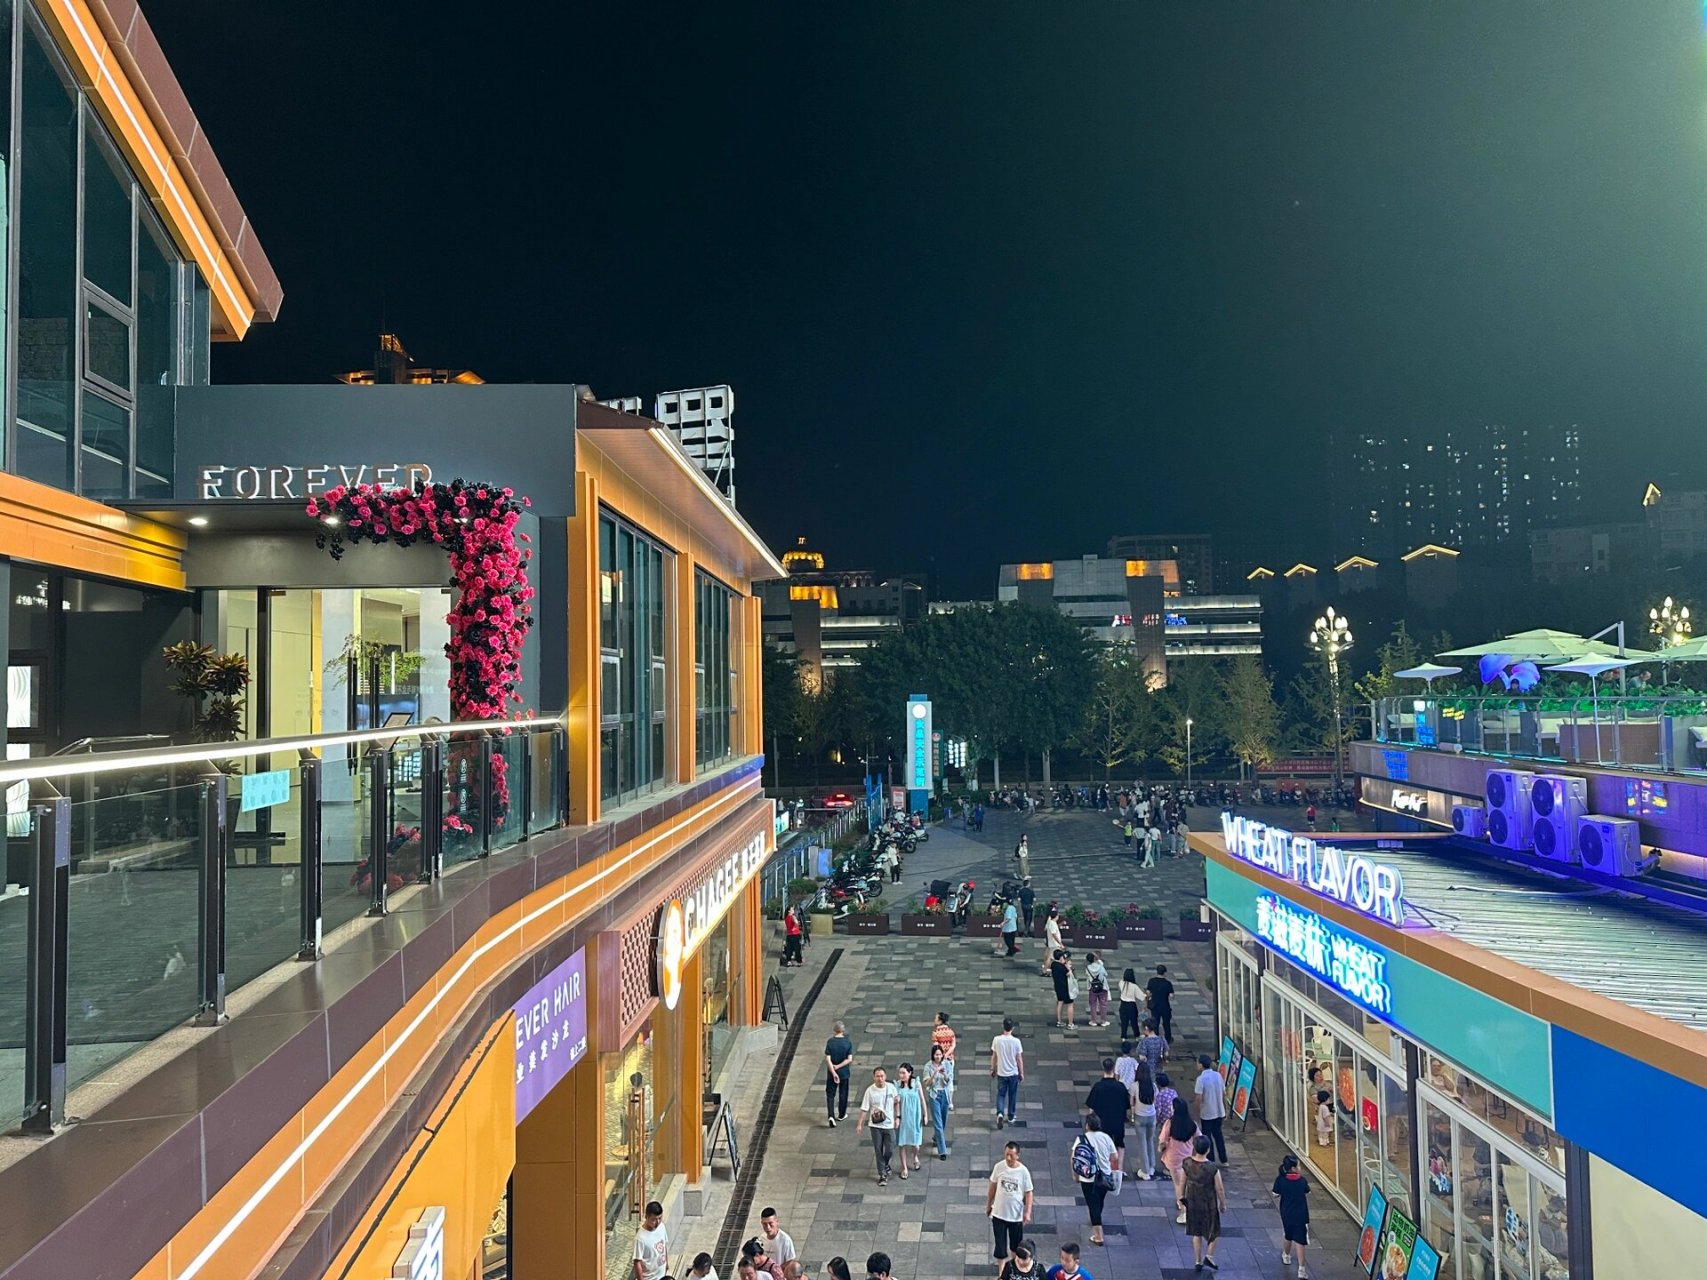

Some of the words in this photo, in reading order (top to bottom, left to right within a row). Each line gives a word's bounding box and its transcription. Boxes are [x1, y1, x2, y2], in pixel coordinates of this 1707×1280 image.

[199, 463, 433, 499] FOREVER
[684, 852, 739, 946] CHAGEE
[1221, 812, 1290, 875] WHEAT
[1292, 838, 1404, 926] FLAVOR
[1331, 934, 1384, 981] WHEAT
[1333, 960, 1389, 1012] FLAVOR
[516, 996, 549, 1050] EVER
[554, 971, 581, 1016] HAIR
